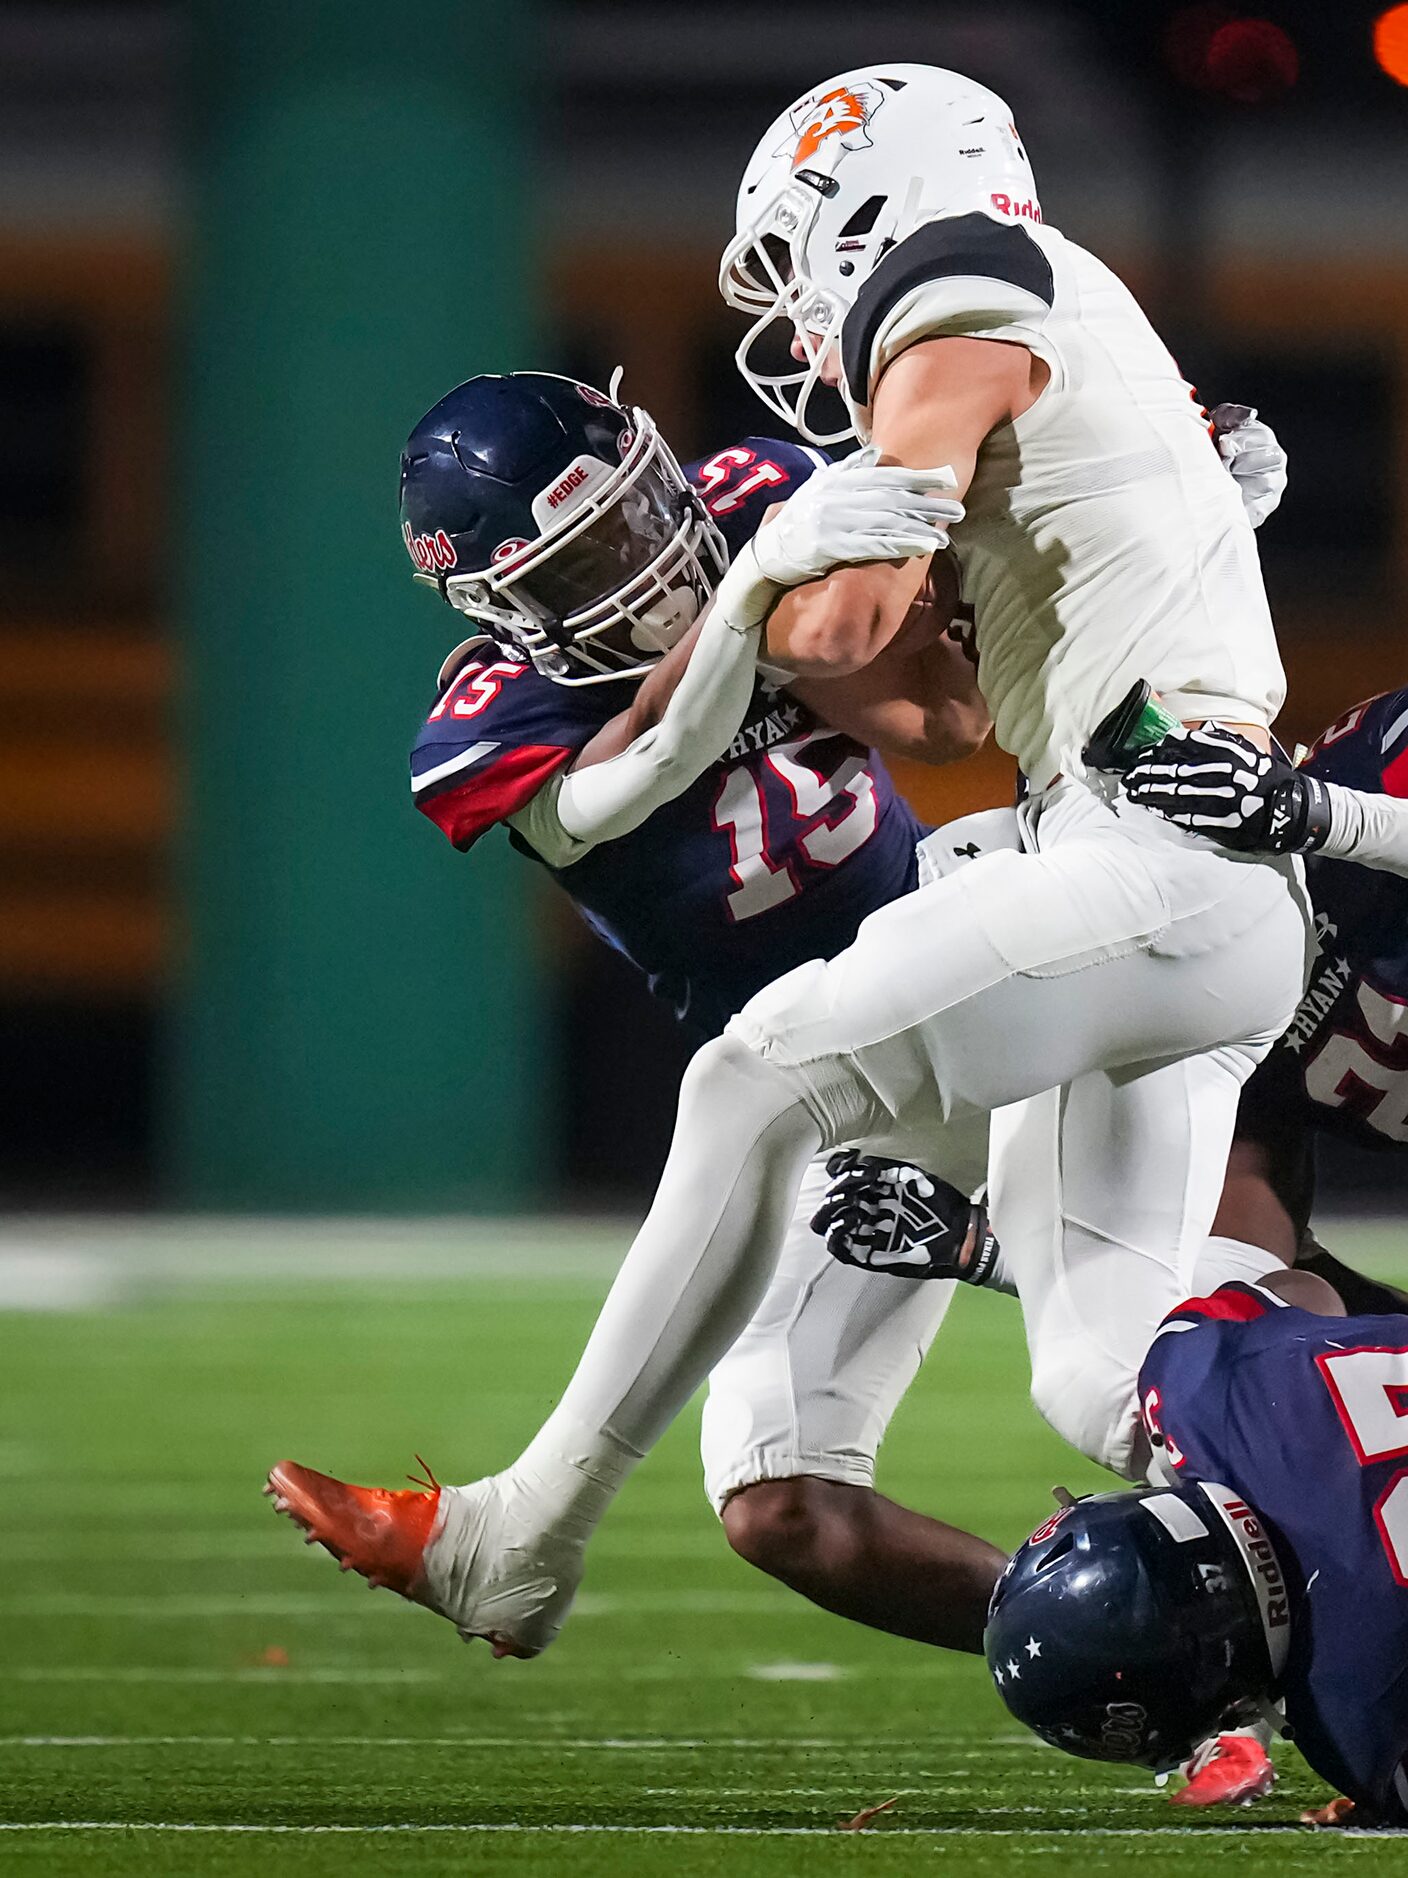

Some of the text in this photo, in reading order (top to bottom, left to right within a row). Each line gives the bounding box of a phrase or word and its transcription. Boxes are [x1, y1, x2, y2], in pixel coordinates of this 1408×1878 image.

[547, 466, 589, 509] #EDGE
[699, 447, 790, 517] 15
[427, 661, 529, 724] 15
[711, 730, 880, 925] 15
[1223, 1501, 1290, 1628] Riddell
